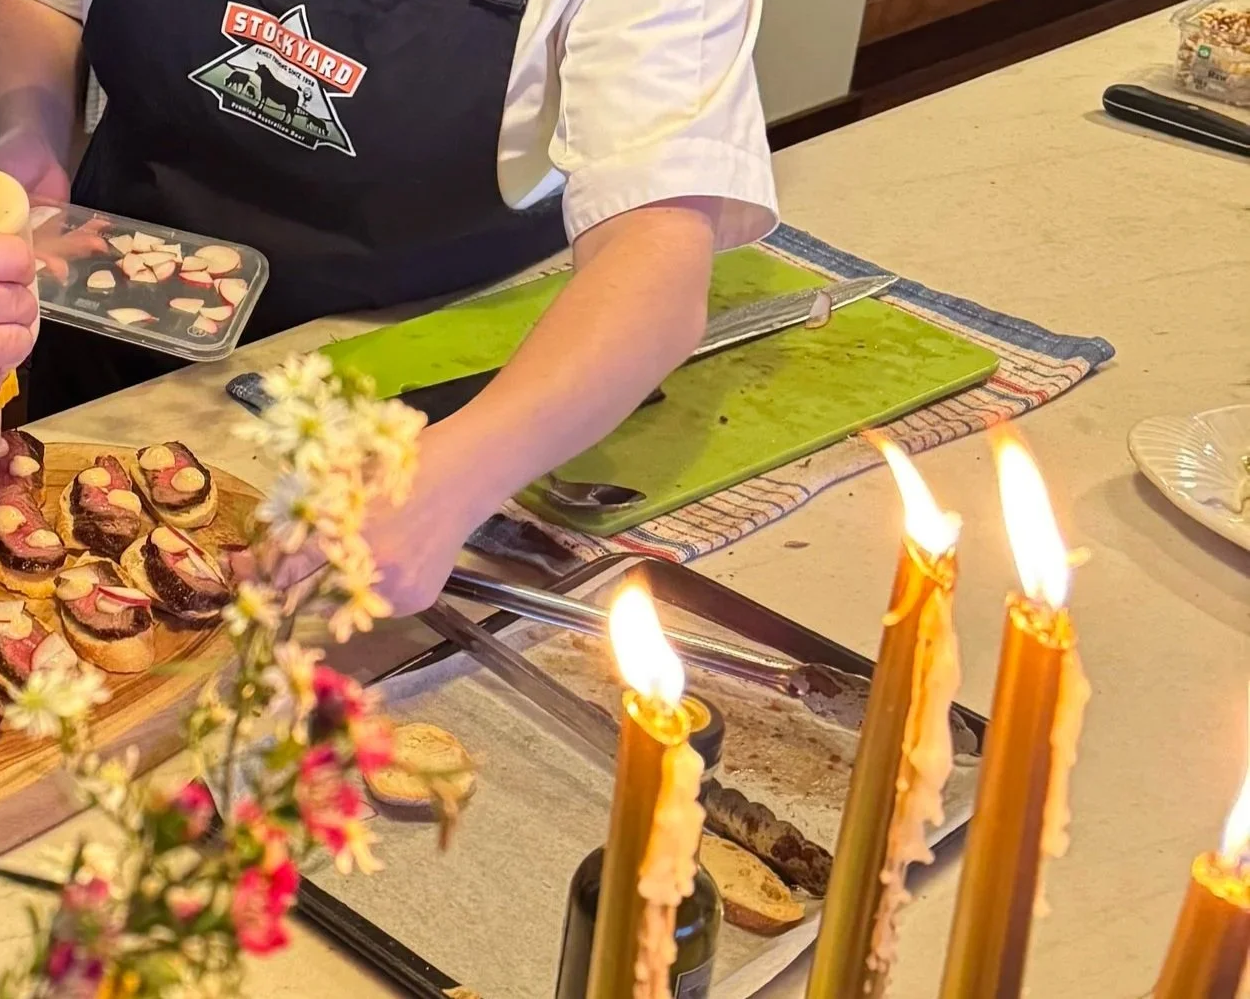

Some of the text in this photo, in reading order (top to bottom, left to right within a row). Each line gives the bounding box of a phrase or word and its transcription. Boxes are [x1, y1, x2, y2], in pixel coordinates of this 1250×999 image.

[232, 11, 353, 86] STOCKYARD
[255, 48, 272, 59] FAMILY
[288, 68, 302, 80] SINCE
[231, 102, 306, 141] Premium Australian Beef
